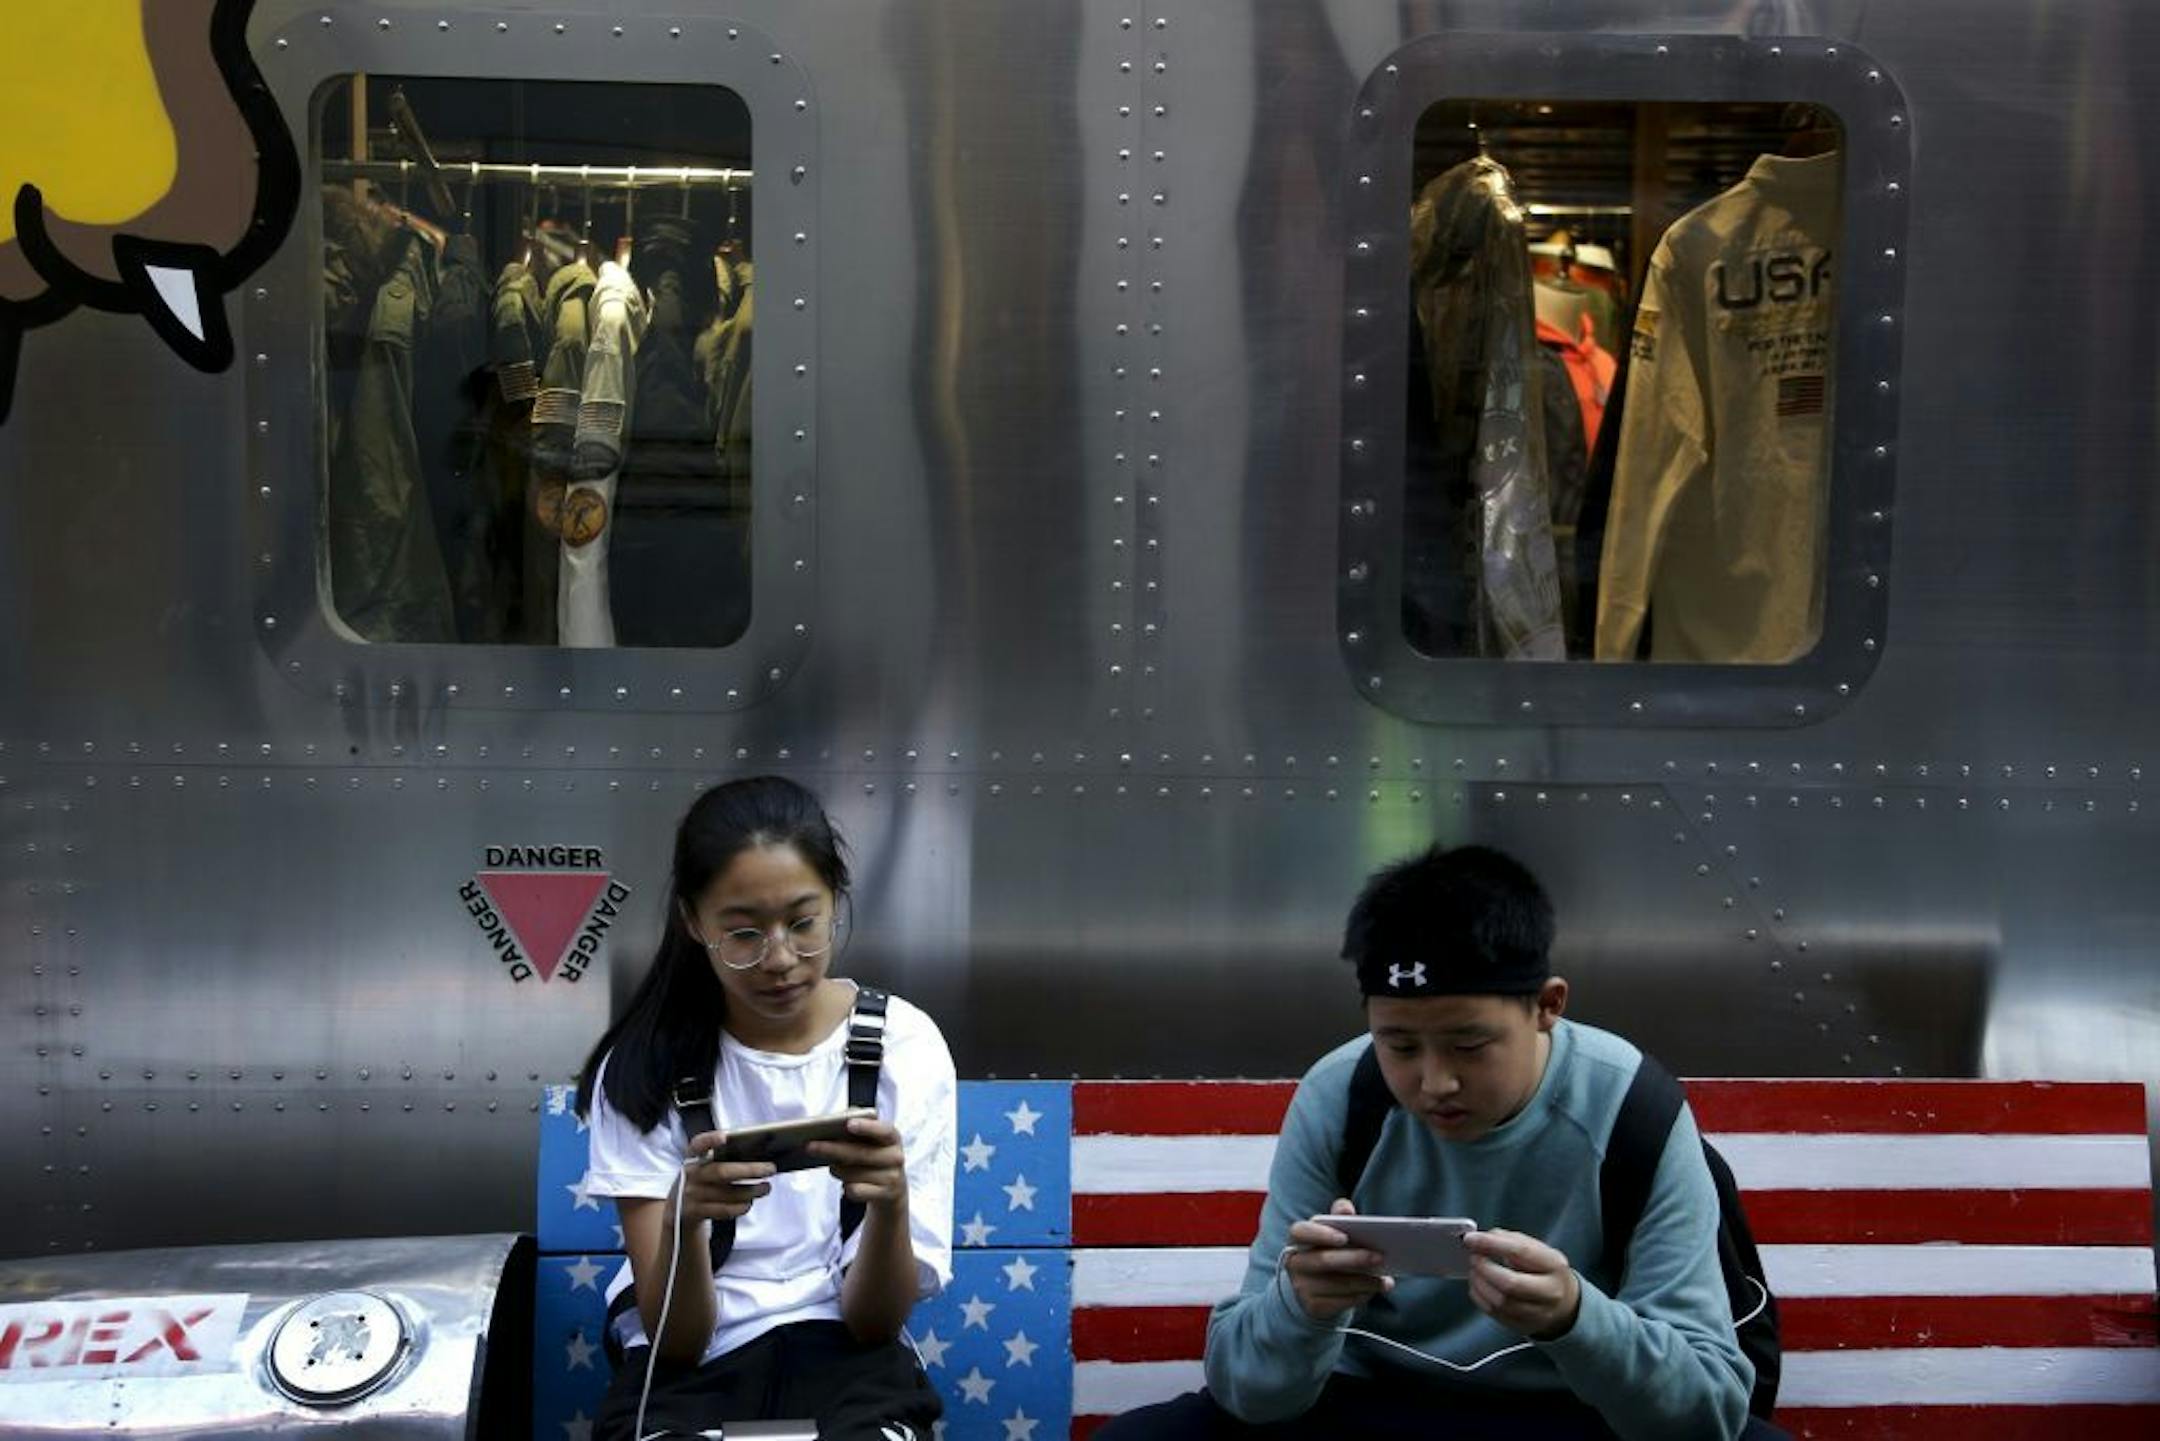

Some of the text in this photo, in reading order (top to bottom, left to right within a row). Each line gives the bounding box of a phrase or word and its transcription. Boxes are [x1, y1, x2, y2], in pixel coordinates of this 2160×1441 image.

[486, 847, 602, 868] DANGER
[459, 880, 533, 984] DANGER
[558, 882, 631, 984] DANGER
[0, 1308, 215, 1369] REX
